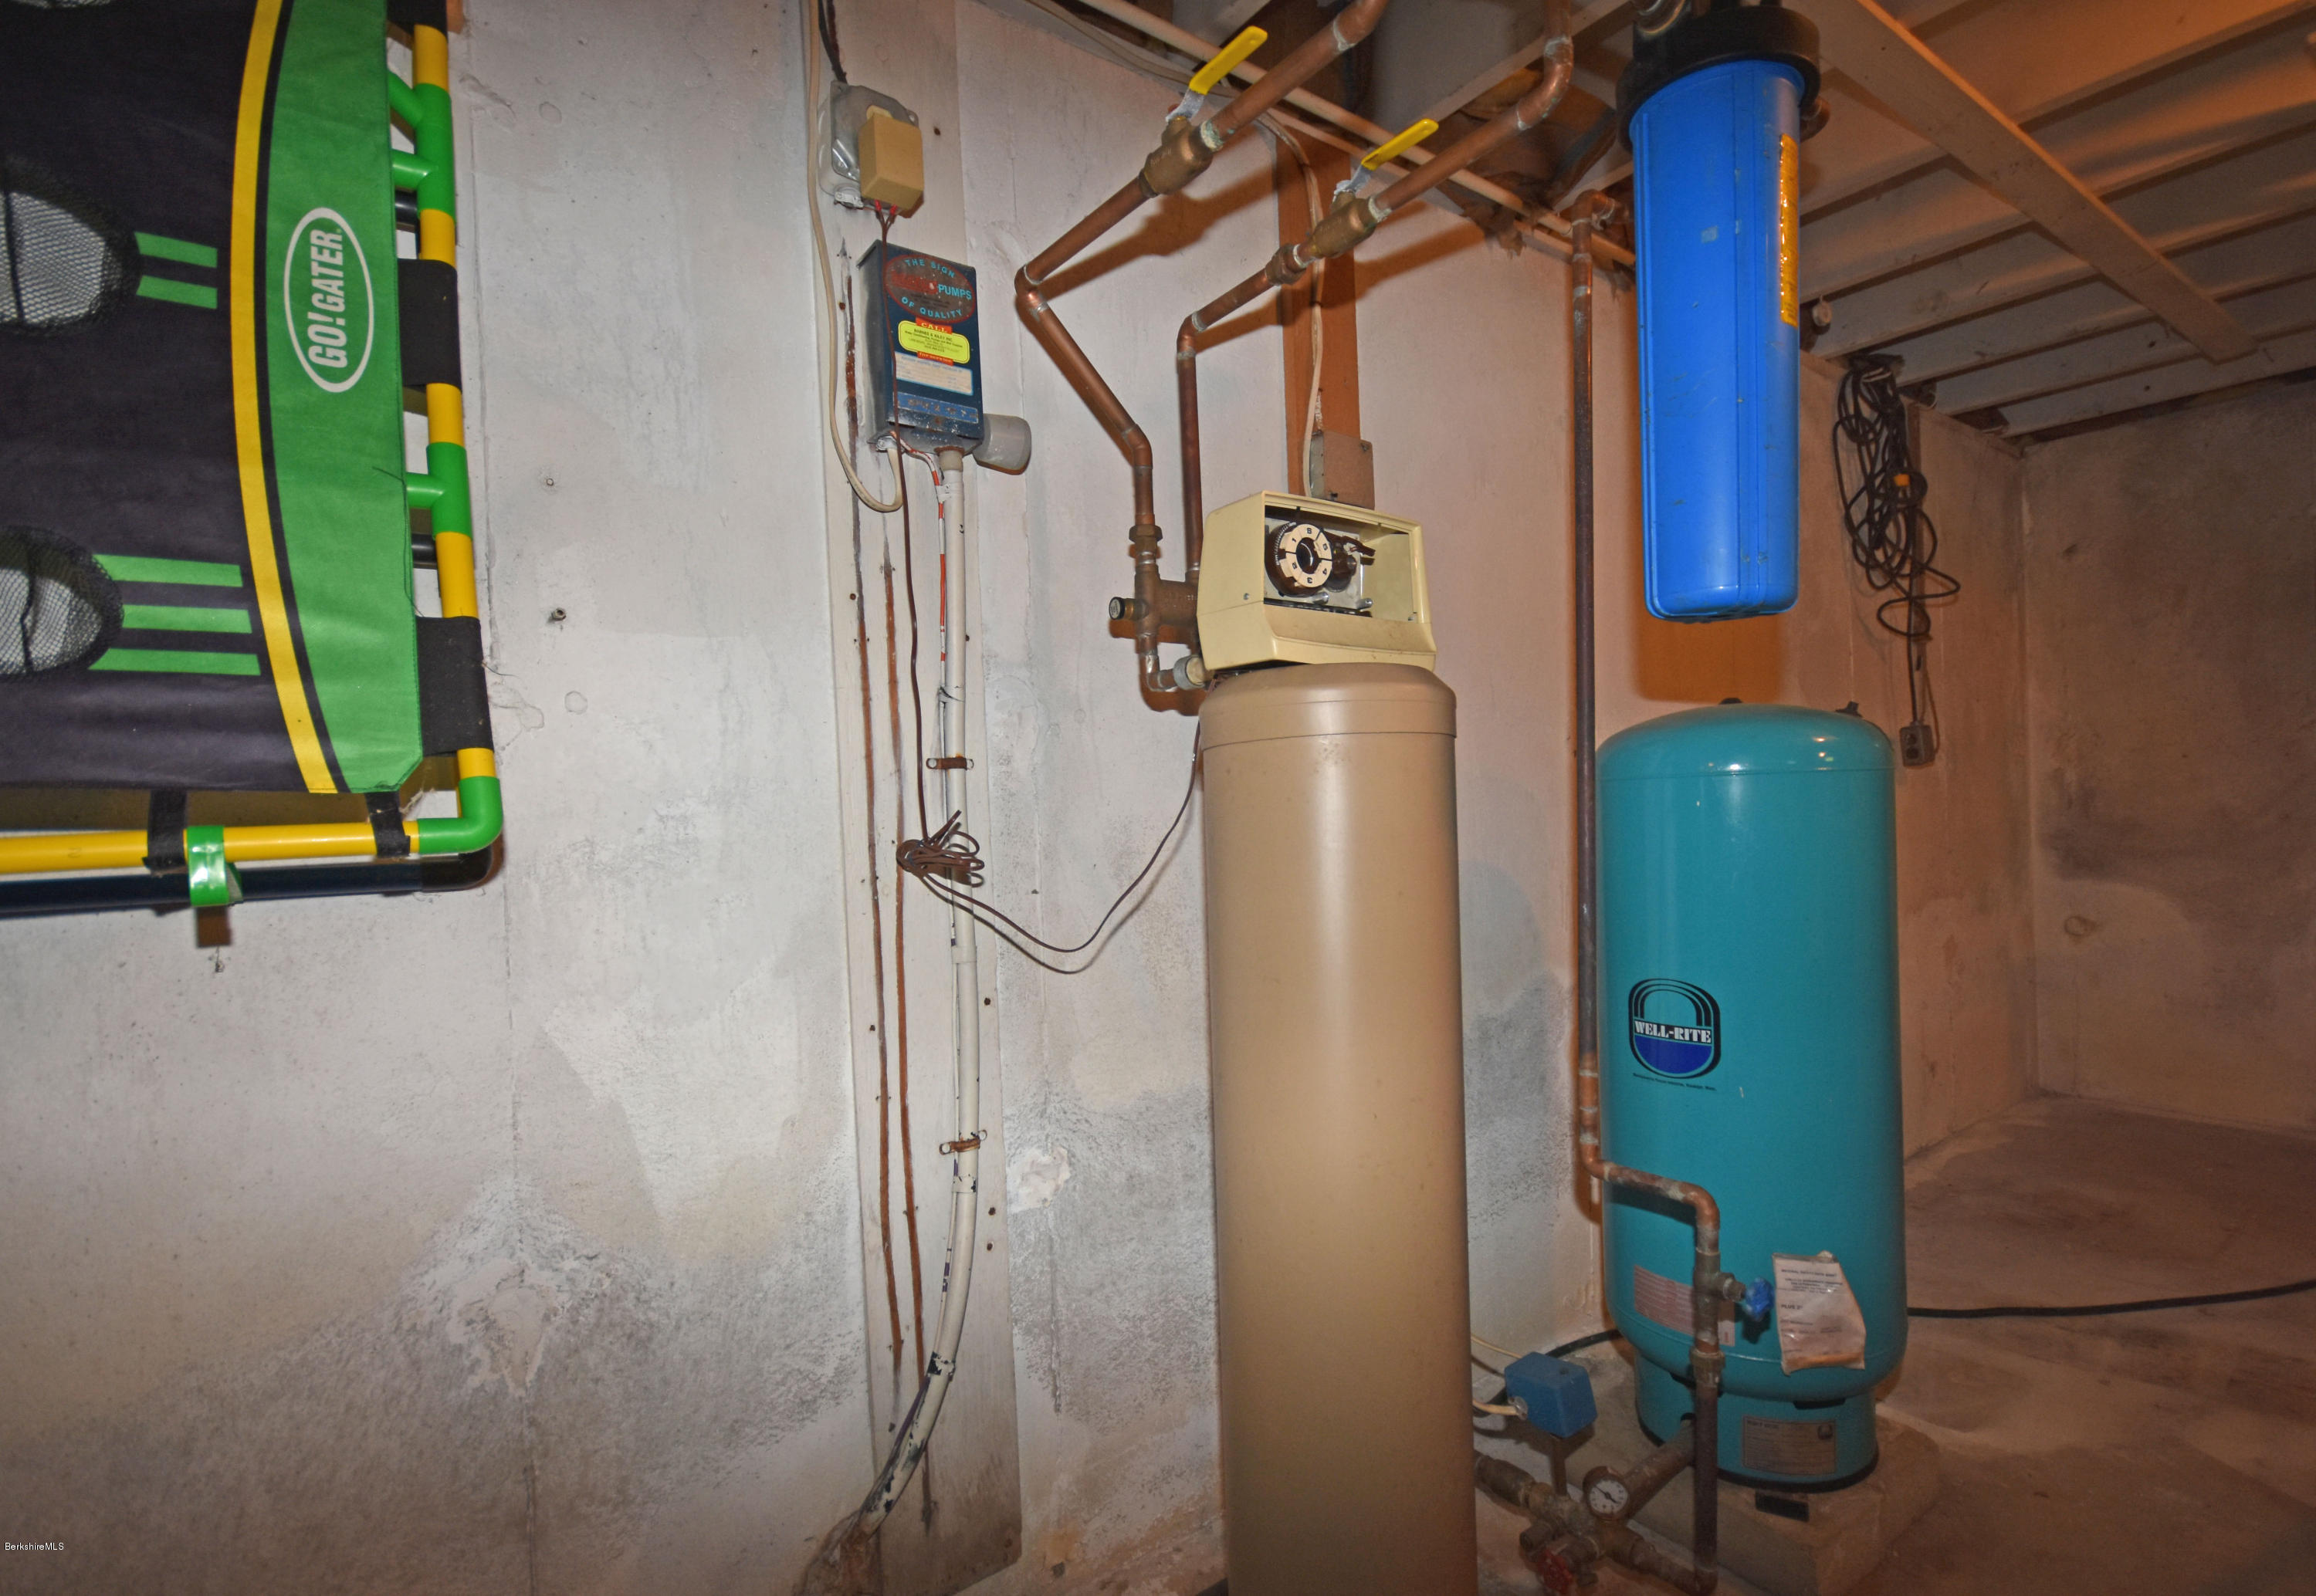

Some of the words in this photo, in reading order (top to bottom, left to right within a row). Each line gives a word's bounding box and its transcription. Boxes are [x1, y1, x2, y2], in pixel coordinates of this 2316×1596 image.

[930, 261, 955, 279] SIGN
[937, 284, 973, 300] PUMPS
[901, 296, 915, 308] OF
[919, 307, 963, 320] QUALITY
[921, 322, 948, 333] CALL
[1634, 1020, 1712, 1043] WELL-RITE
